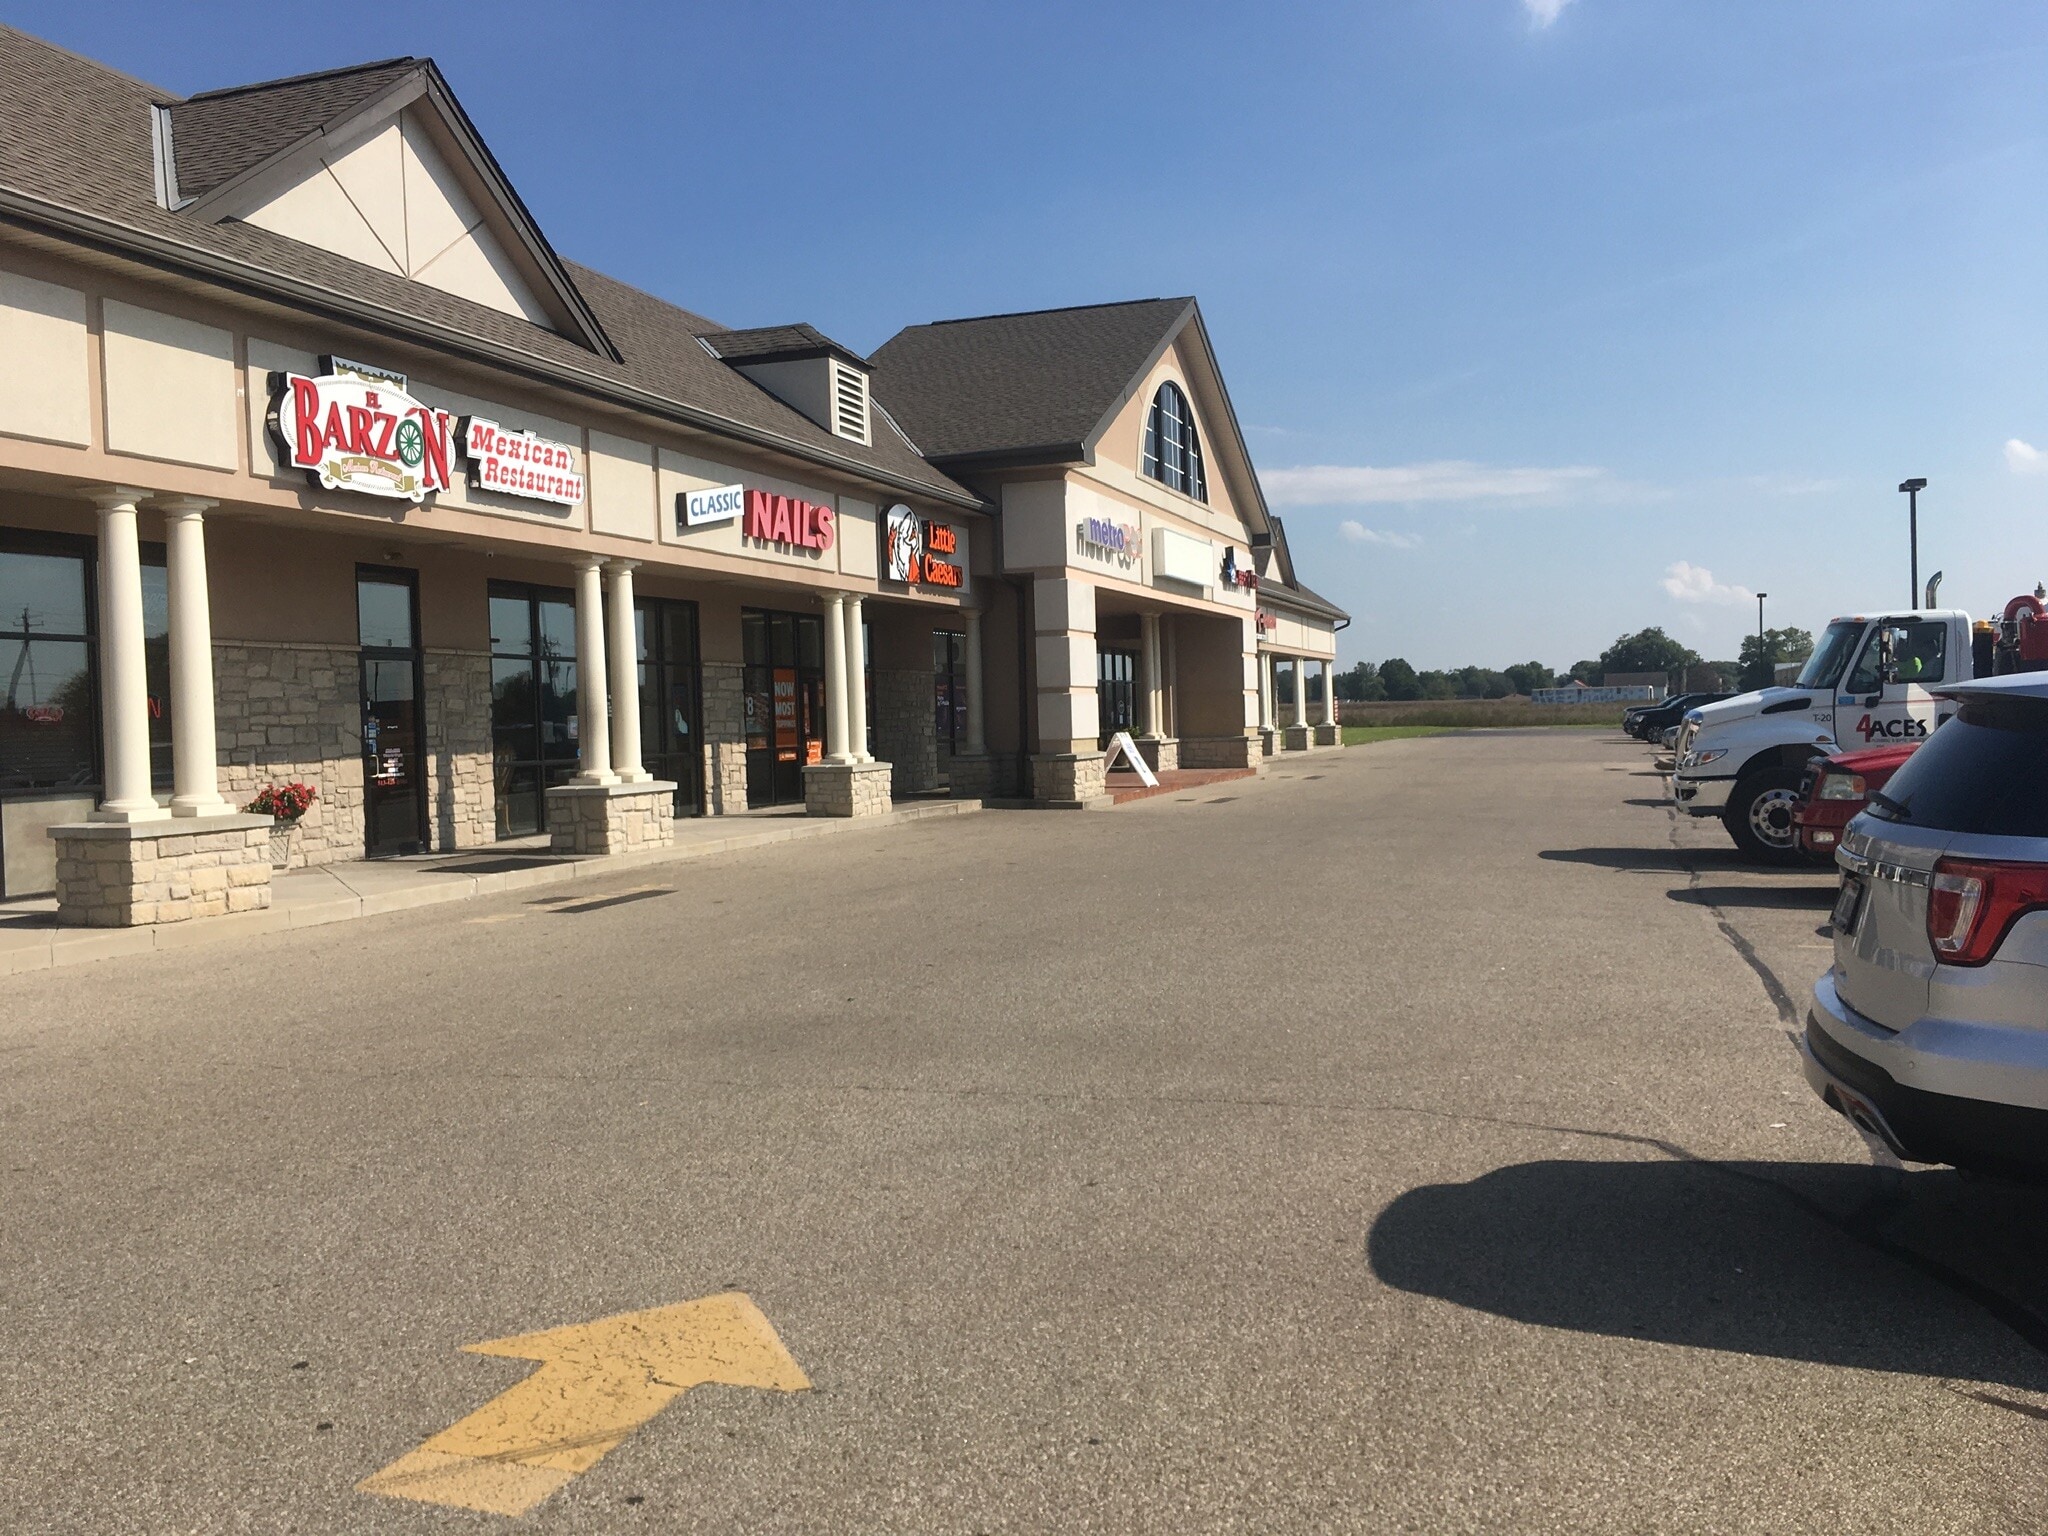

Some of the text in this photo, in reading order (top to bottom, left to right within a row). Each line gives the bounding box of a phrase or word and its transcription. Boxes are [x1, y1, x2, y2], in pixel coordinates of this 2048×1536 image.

[471, 424, 569, 470] Mexican
[484, 457, 582, 500] Restaurant
[690, 490, 742, 517] CLASSIC
[752, 489, 835, 551] NAILS
[929, 520, 956, 554] Little
[774, 681, 795, 697] NOW
[775, 701, 796, 716] MOST
[1813, 713, 1832, 722] T-20
